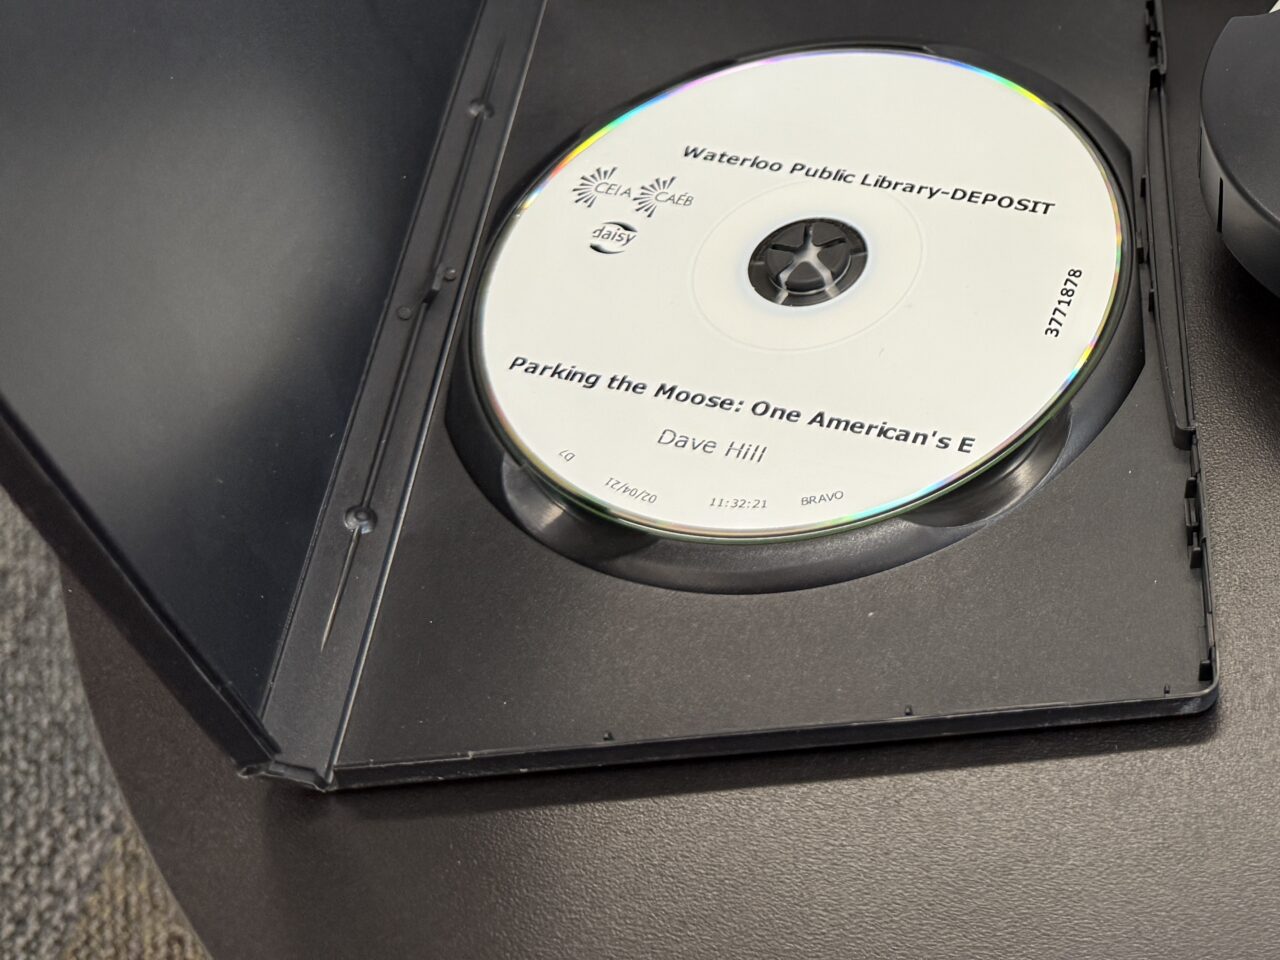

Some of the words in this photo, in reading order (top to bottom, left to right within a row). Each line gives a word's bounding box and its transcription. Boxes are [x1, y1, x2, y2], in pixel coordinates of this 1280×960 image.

[682, 144, 783, 173] Waterloo
[789, 161, 855, 185] Public
[860, 173, 1056, 216] Library-DEPOSIT
[592, 225, 637, 247] daisy
[1044, 268, 1083, 338] 3771878
[508, 355, 602, 390] Parking
[606, 373, 647, 396] the
[653, 382, 743, 414] Moose:
[750, 400, 801, 424] One
[807, 410, 952, 451] American's
[956, 435, 977, 454] E
[656, 428, 718, 455] Dave
[723, 440, 768, 464] Hill
[603, 476, 659, 504] 02/04/21
[709, 497, 768, 509] 11:32:21
[800, 489, 845, 507] BRAVO
